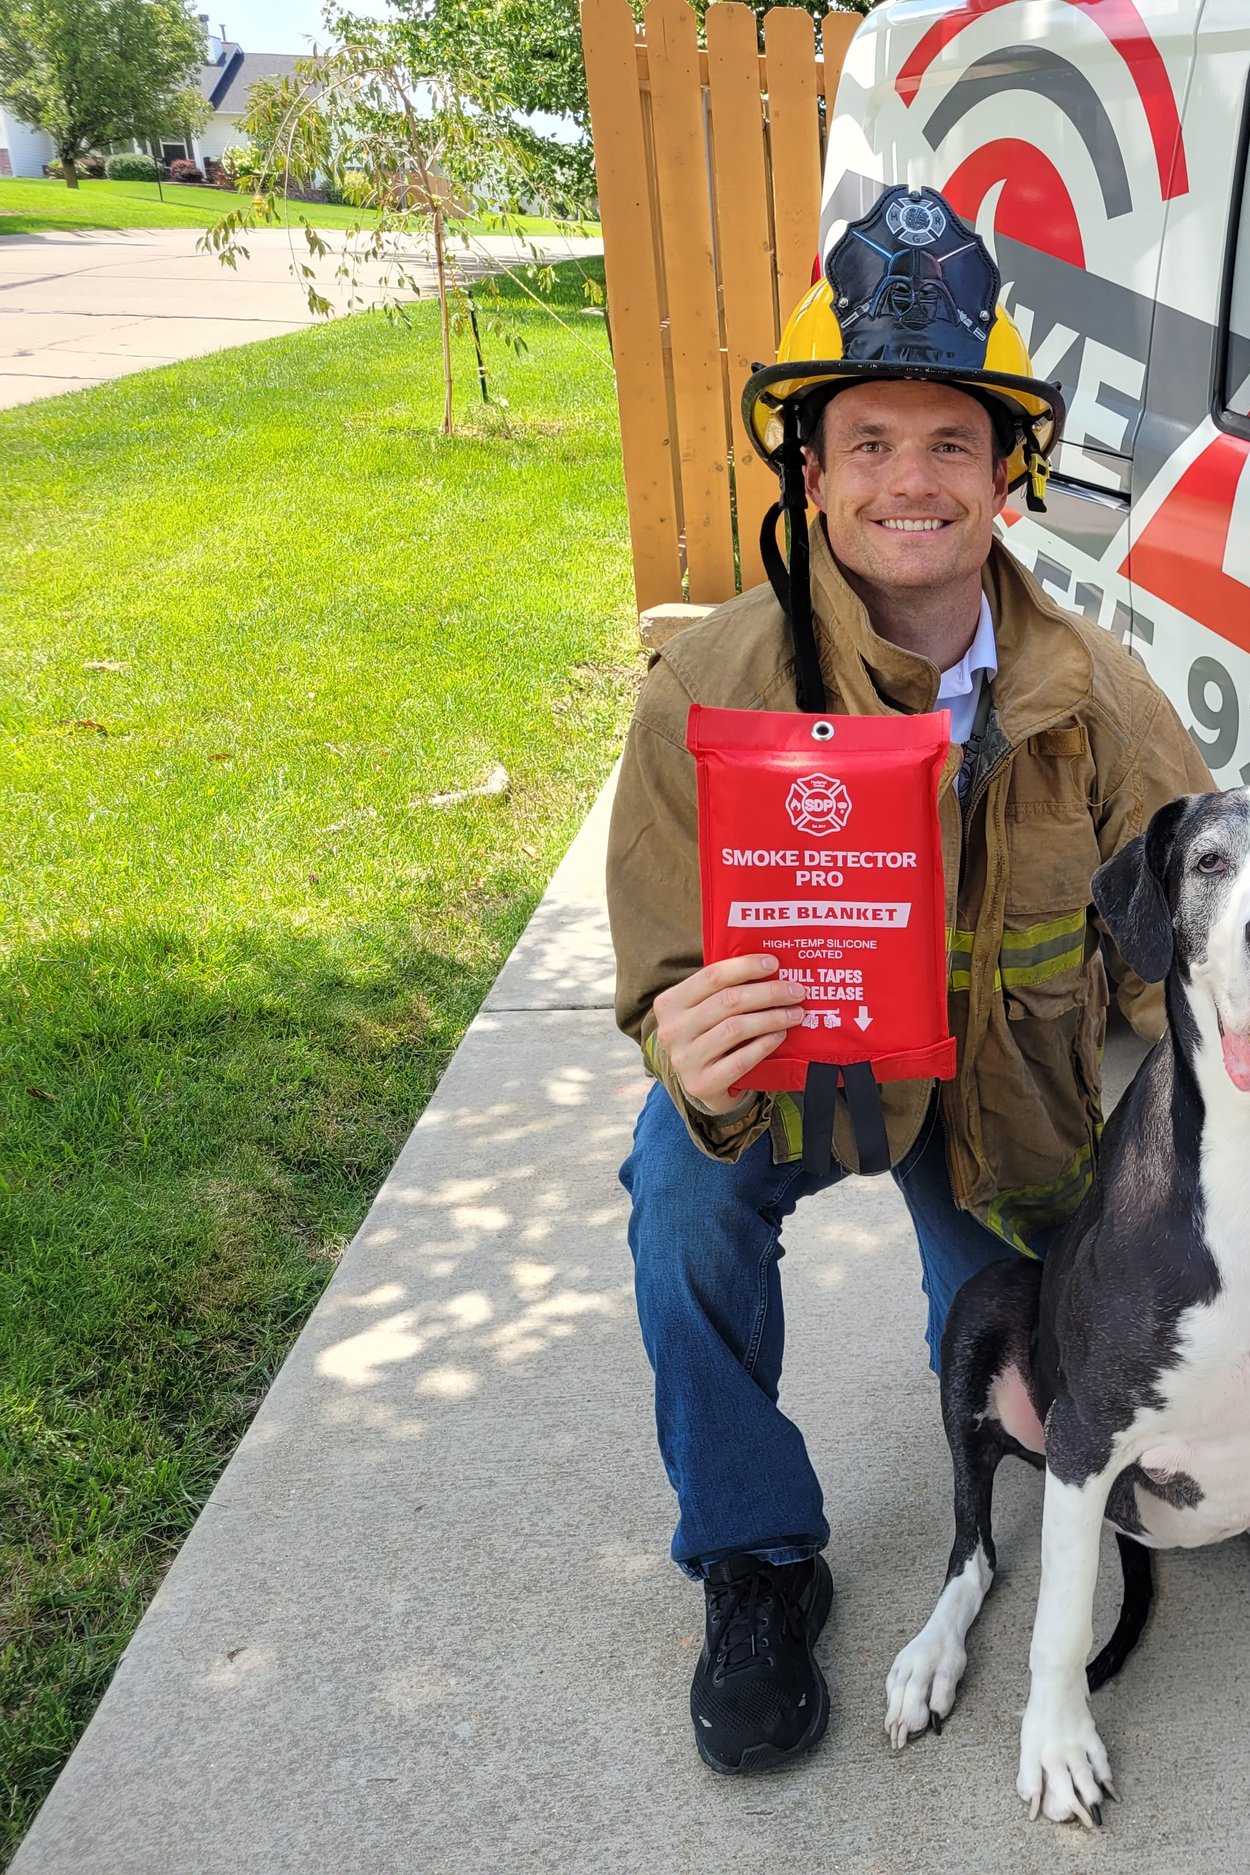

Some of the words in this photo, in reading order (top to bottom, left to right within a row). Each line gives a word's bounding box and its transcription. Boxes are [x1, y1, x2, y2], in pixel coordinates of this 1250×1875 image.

[804, 798, 834, 812] SDP
[722, 848, 799, 867] SMOKE
[804, 851, 917, 868] DETECTOR
[796, 870, 844, 887] PRO
[740, 907, 790, 921] FIRE
[797, 906, 898, 921] BLANKET
[763, 938, 824, 948] HIGH-TEMP
[826, 939, 878, 949] SILICONE
[798, 950, 843, 959] COATED
[779, 968, 814, 982] PULL
[817, 969, 863, 984] TAPES
[804, 986, 864, 1000] RELEASE
